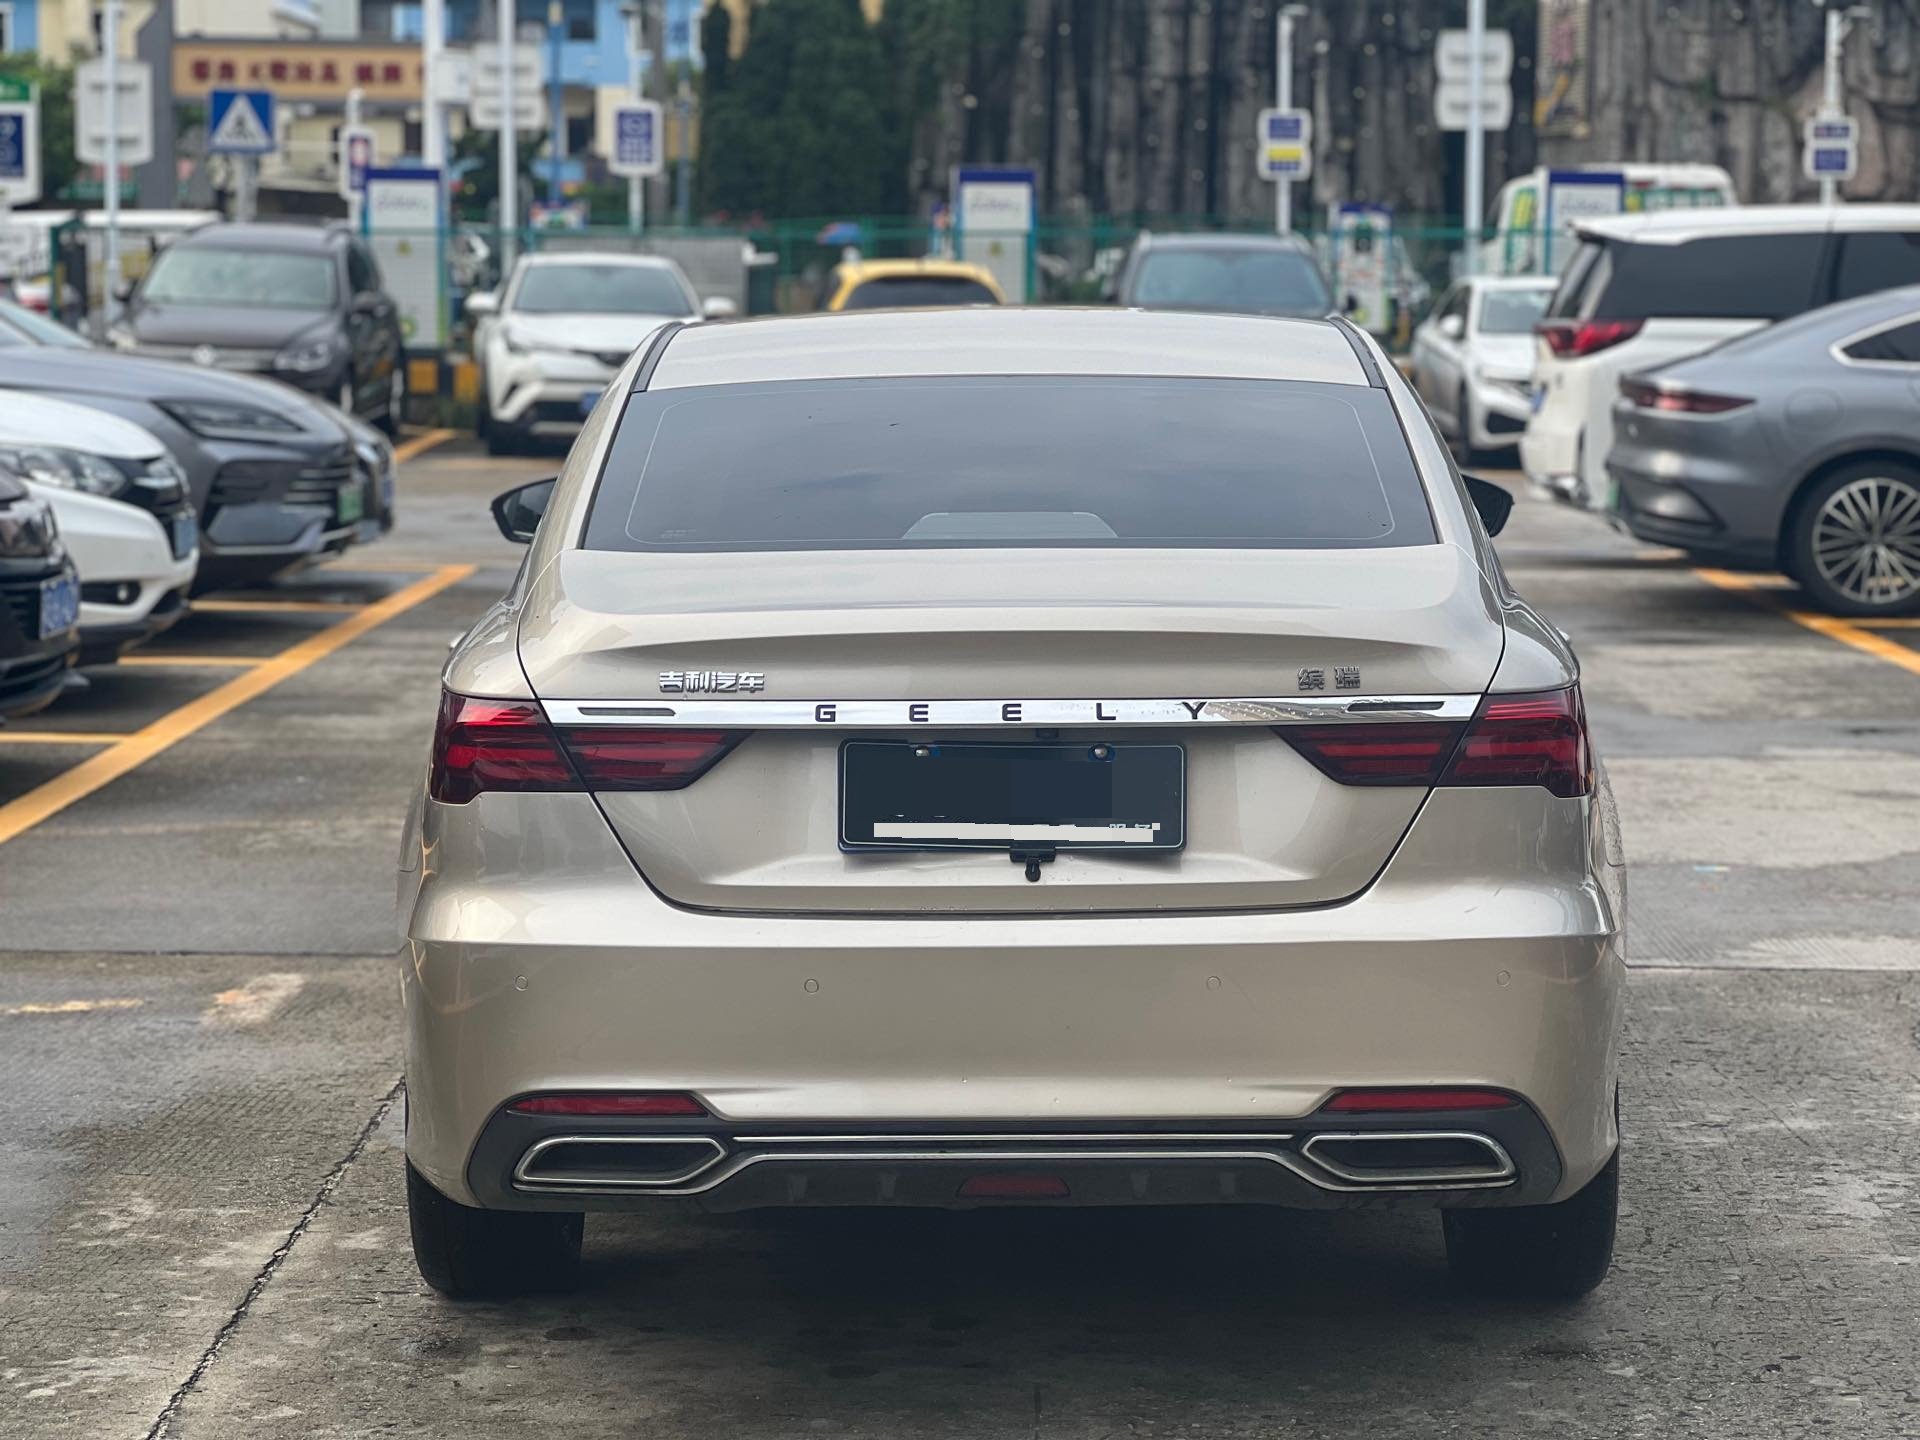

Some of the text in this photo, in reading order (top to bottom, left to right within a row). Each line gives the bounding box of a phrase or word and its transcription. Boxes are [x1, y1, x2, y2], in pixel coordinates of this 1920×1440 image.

[659, 671, 765, 693] 吉利汽车
[1298, 666, 1361, 690] 缤瑞
[814, 702, 1207, 722] GEELY
